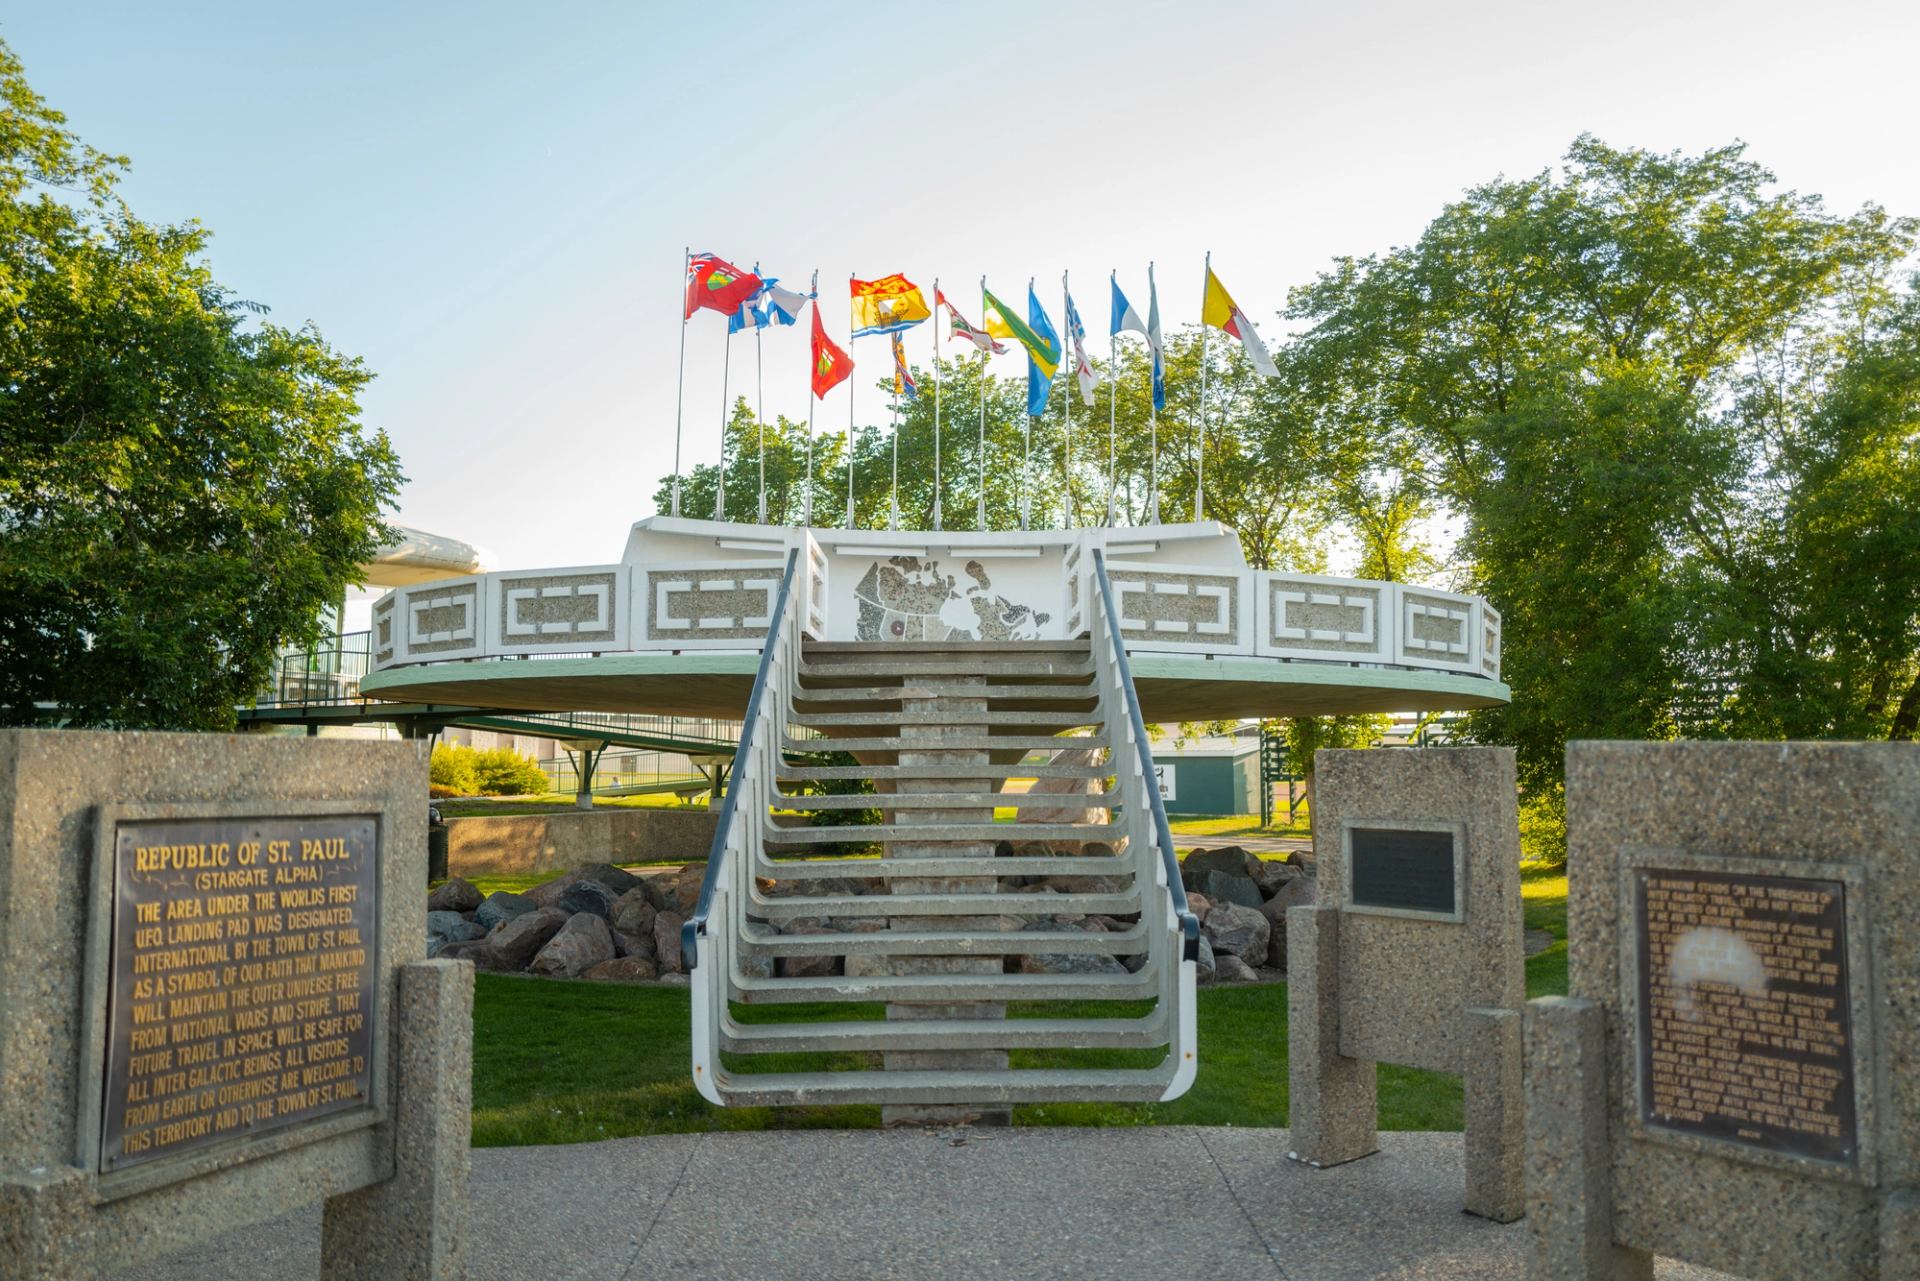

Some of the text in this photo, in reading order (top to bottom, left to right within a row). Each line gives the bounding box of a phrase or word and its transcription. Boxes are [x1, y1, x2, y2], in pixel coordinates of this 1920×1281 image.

[136, 838, 349, 870] REPUBLIC OF ST. PAUL
[195, 864, 323, 890] (STARGATE ALPHA)
[136, 885, 357, 923] THE AREA UNDER THE WORLDS FIRST
[169, 920, 223, 944] LANDING
[228, 917, 249, 937] PAD
[255, 914, 282, 934] WAS
[289, 906, 352, 930] DESIGNATED
[135, 943, 230, 973] INTERNATIONAL
[235, 941, 248, 960] BY
[253, 938, 271, 957] THE
[276, 934, 304, 954] TOWN
[308, 932, 320, 950] OF
[339, 927, 360, 945] PAUL
[135, 978, 152, 999] AS
[156, 977, 164, 996] A
[224, 966, 237, 986] OF
[241, 963, 263, 983] OUR
[266, 958, 292, 979] FAITH
[296, 955, 316, 975] THAT
[320, 948, 365, 971] MANKIND
[131, 1026, 167, 1051] FROM
[172, 1015, 231, 1043] NATIONAL
[235, 1008, 268, 1031] WARS
[272, 1003, 294, 1024] AND
[336, 992, 360, 1012] THAT
[134, 970, 359, 1025] WILL MAINTAIN THE OUTER UNIVERSE FREE
[128, 1079, 149, 1103] ALL
[154, 1071, 186, 1097] INTER
[189, 1060, 240, 1089] GALACTIC
[286, 1046, 304, 1067] ALL
[308, 1037, 349, 1062] VISITORS
[130, 1012, 363, 1077] FUTURE TRAVEL IN SPACE WILL BE SAFE FOR
[126, 1055, 363, 1129] FROM EARTH OR OTHERWISE ARE WELCOME TO
[124, 1129, 150, 1155] THIS
[155, 1114, 212, 1147] TERRITORY
[216, 1107, 238, 1131] AND
[241, 1103, 254, 1124] TO
[256, 1098, 274, 1120] THE
[277, 1090, 307, 1115] TOWN
[309, 1087, 319, 1107] OF
